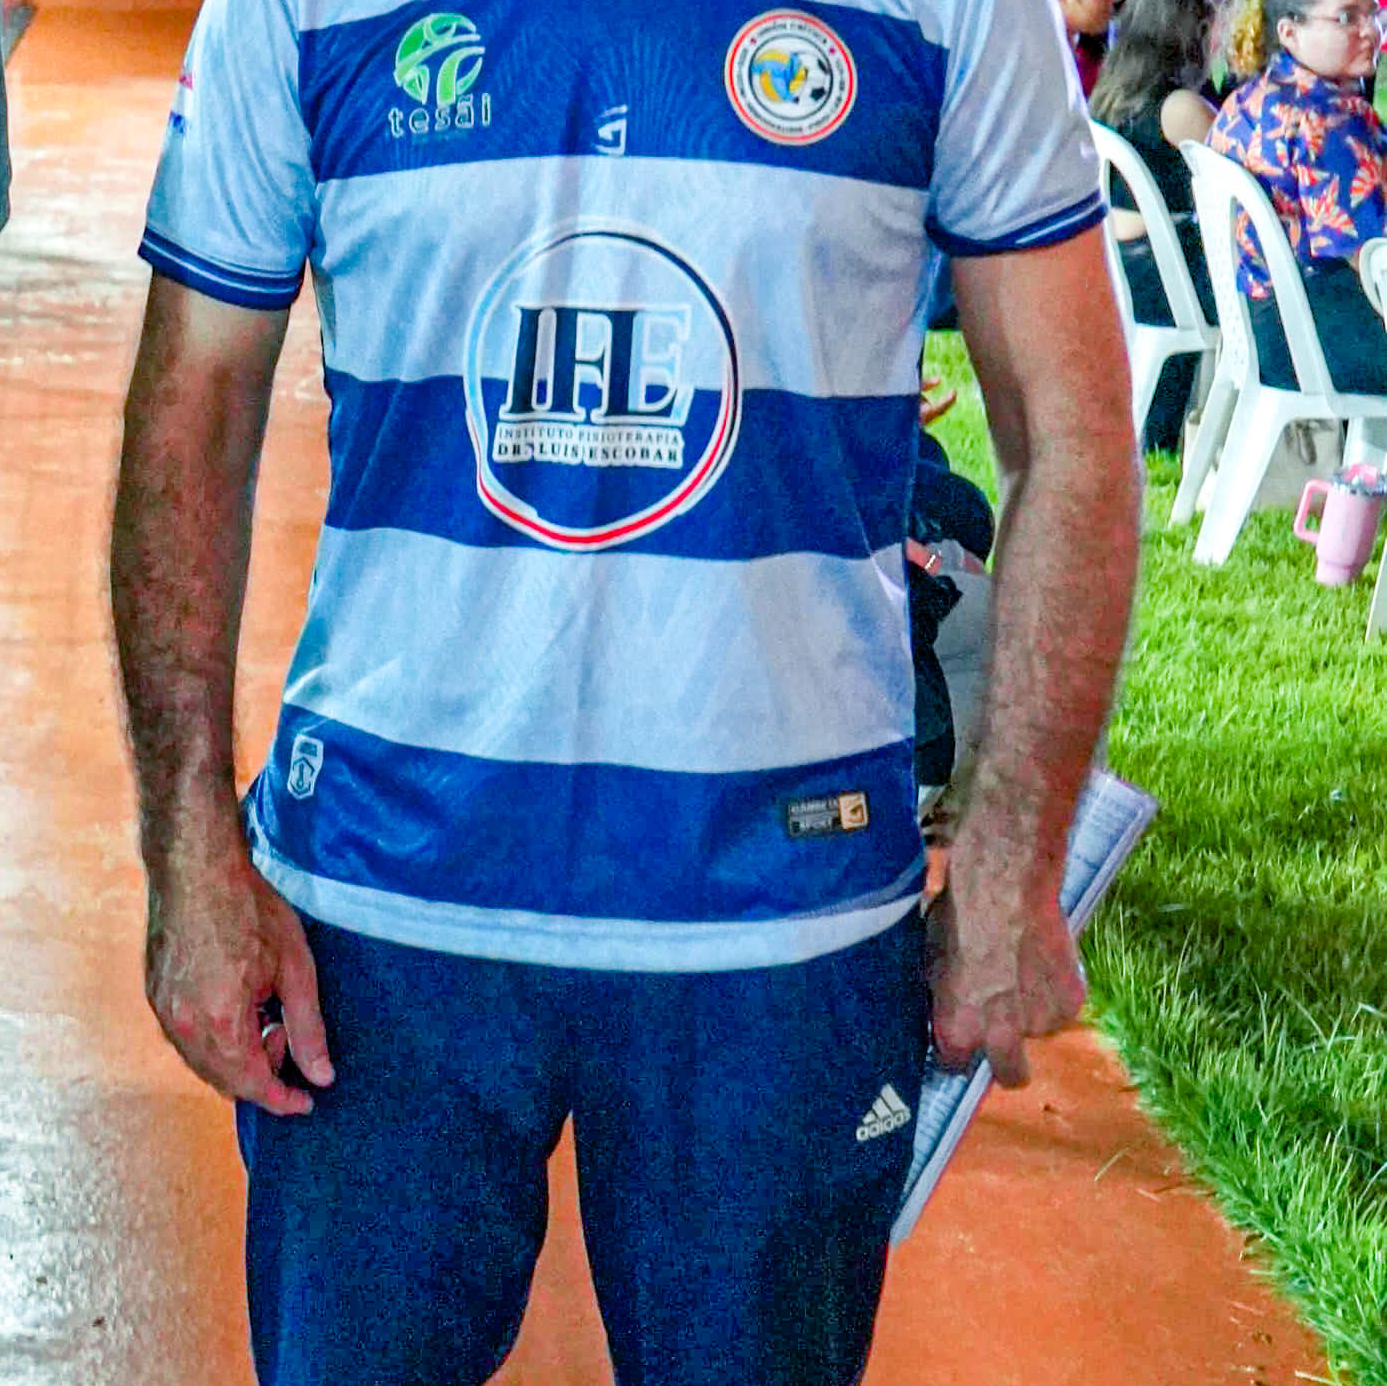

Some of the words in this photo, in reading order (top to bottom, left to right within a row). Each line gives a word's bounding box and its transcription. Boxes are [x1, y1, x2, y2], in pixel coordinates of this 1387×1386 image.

[498, 426, 574, 440] INSTITUTO
[578, 428, 679, 445] FISIOTERAPIA
[538, 442, 580, 458] LUIS
[588, 445, 678, 462] ESCOBAR
[856, 1109, 911, 1141] adidas
